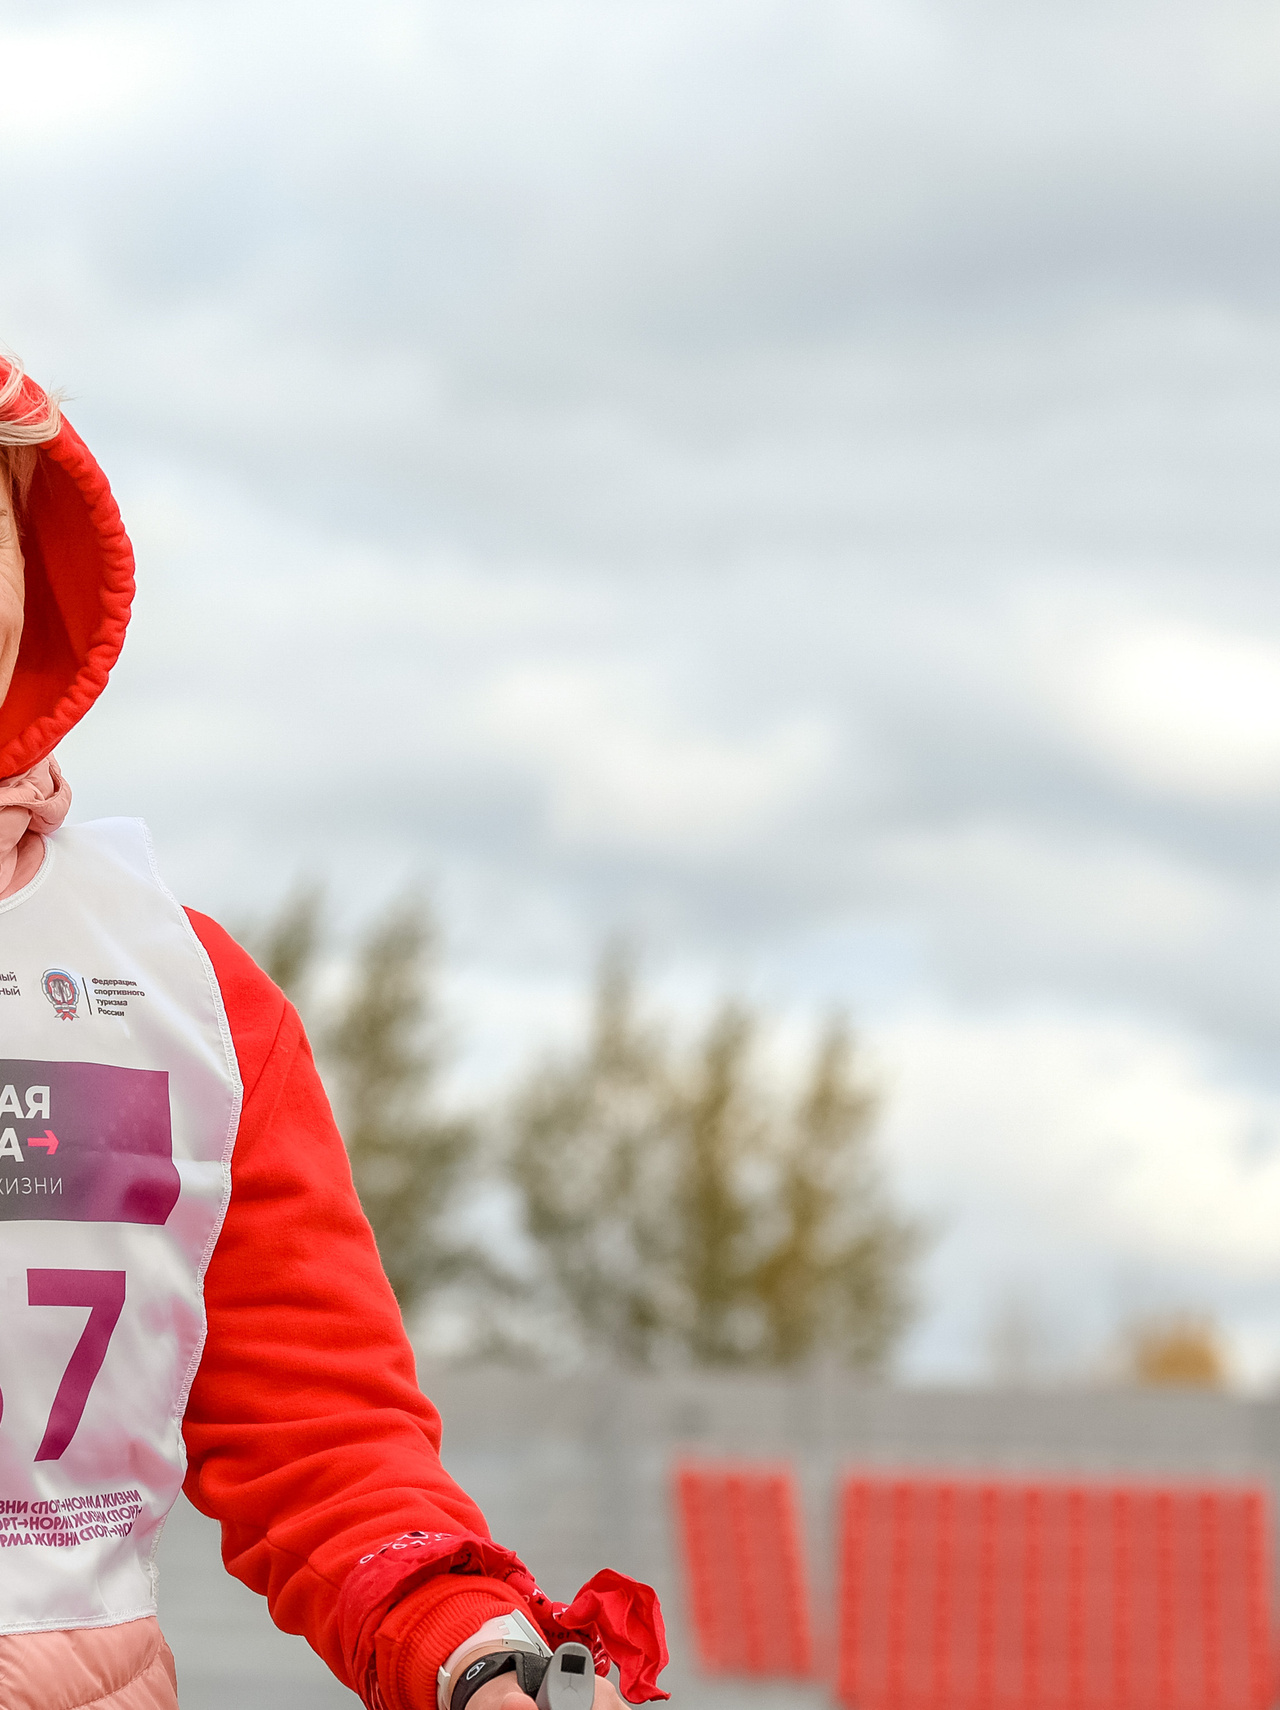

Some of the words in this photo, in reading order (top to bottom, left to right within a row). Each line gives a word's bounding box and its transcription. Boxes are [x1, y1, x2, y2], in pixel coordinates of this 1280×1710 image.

[91, 977, 137, 987] Федерация
[94, 988, 145, 997] спортивного
[96, 998, 128, 1006] туризма
[97, 1007, 124, 1017] России
